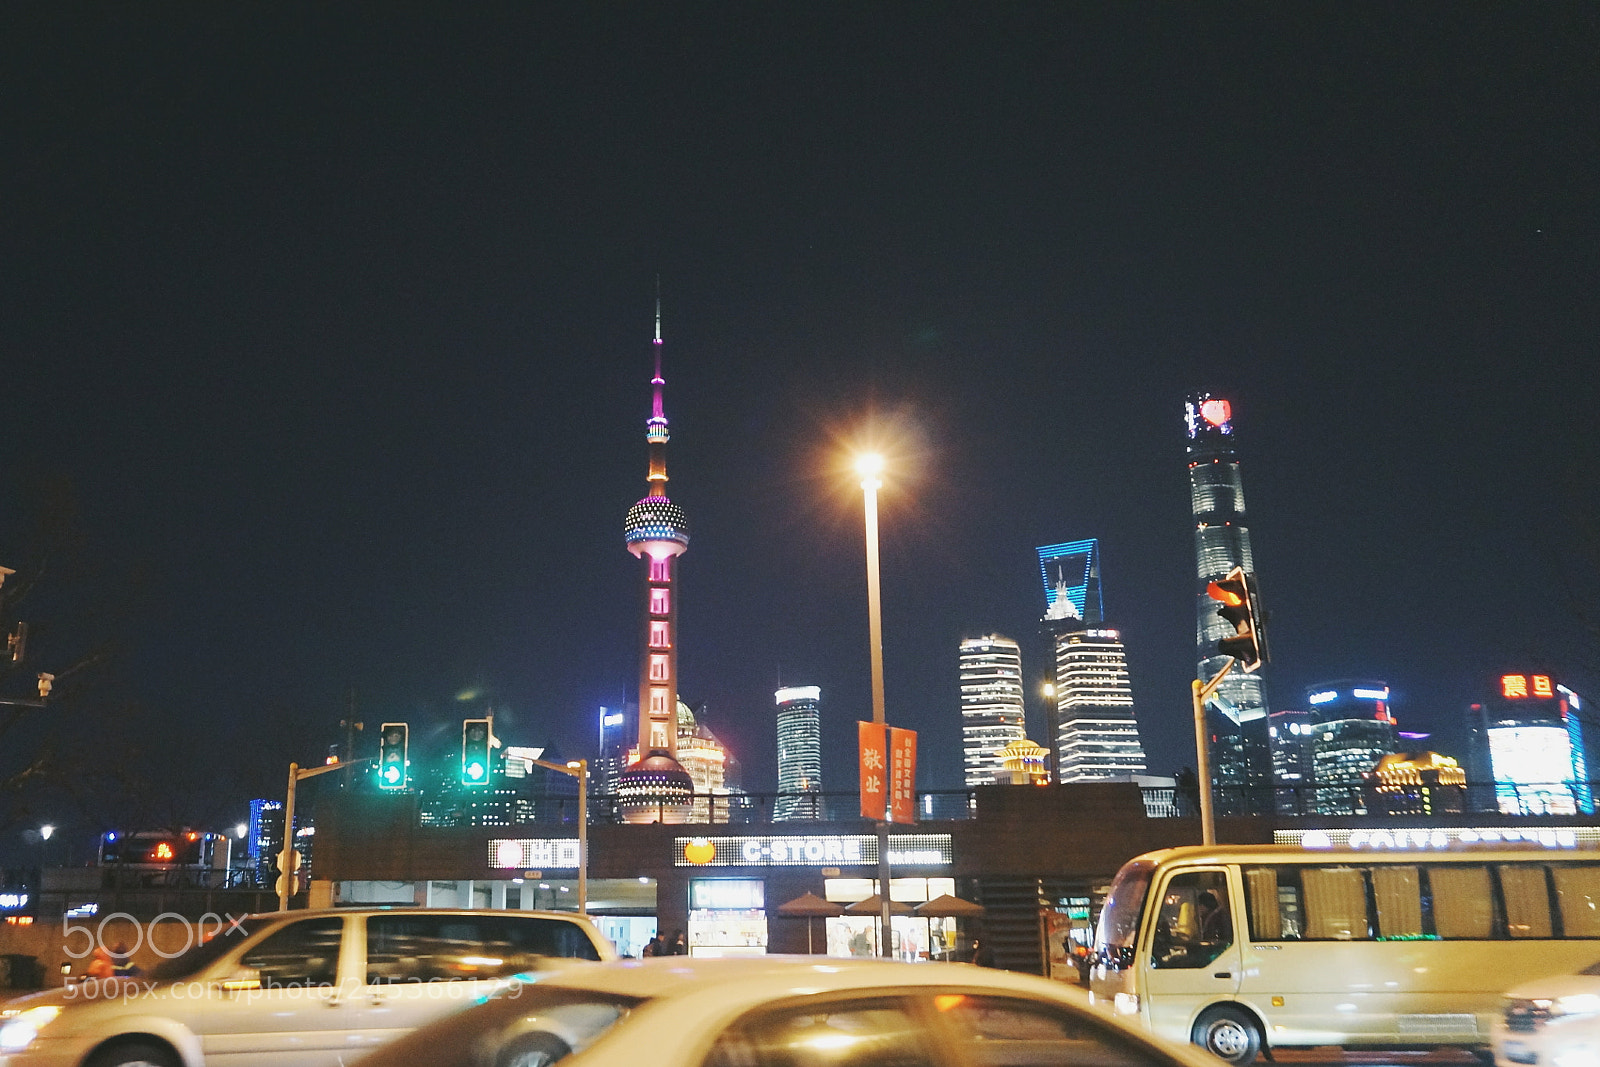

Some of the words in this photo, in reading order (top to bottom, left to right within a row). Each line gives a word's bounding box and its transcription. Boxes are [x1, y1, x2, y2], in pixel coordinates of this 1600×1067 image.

[1502, 674, 1553, 698] 震旦
[863, 748, 883, 793] 敬业
[742, 840, 861, 862] C-STORE
